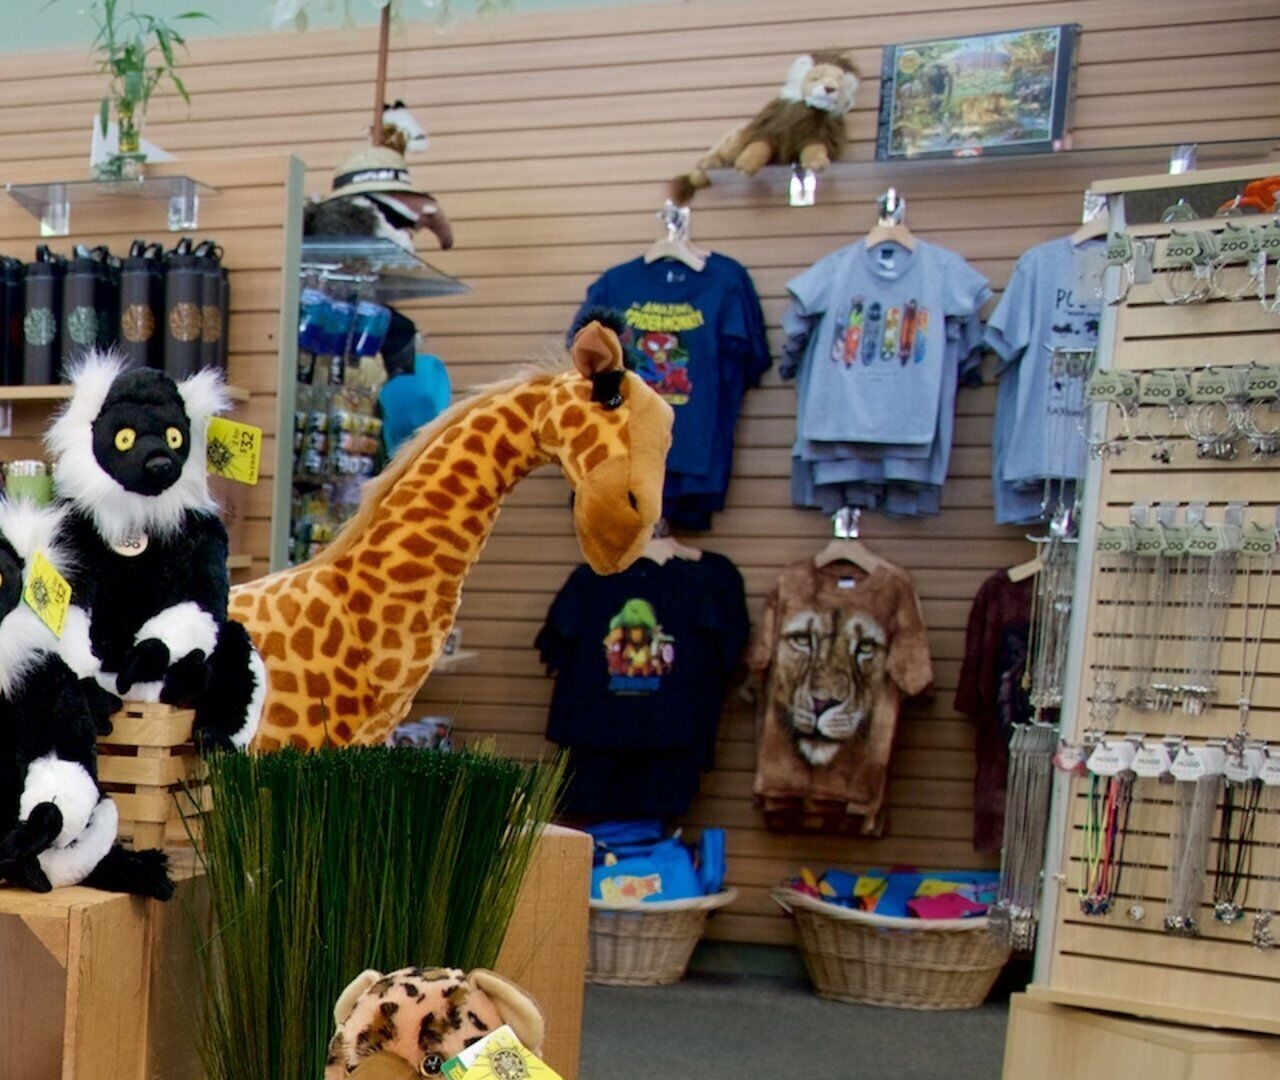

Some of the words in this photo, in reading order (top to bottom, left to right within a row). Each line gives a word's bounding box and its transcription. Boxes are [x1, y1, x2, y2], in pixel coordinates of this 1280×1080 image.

[1220, 240, 1248, 251] ZOO
[1262, 237, 1280, 249] ZO
[1107, 249, 1126, 260] ZOO
[1166, 247, 1194, 257] ZOO
[1089, 385, 1116, 396] ZOO
[1197, 385, 1225, 396] ZOO
[1248, 380, 1277, 391] ZOO
[1143, 387, 1171, 397] ZOO
[239, 431, 254, 455] $32
[1097, 542, 1121, 550] ZOO
[1136, 541, 1160, 550] ZOO
[1189, 540, 1216, 550] ZOO
[1243, 541, 1271, 552] ZOO
